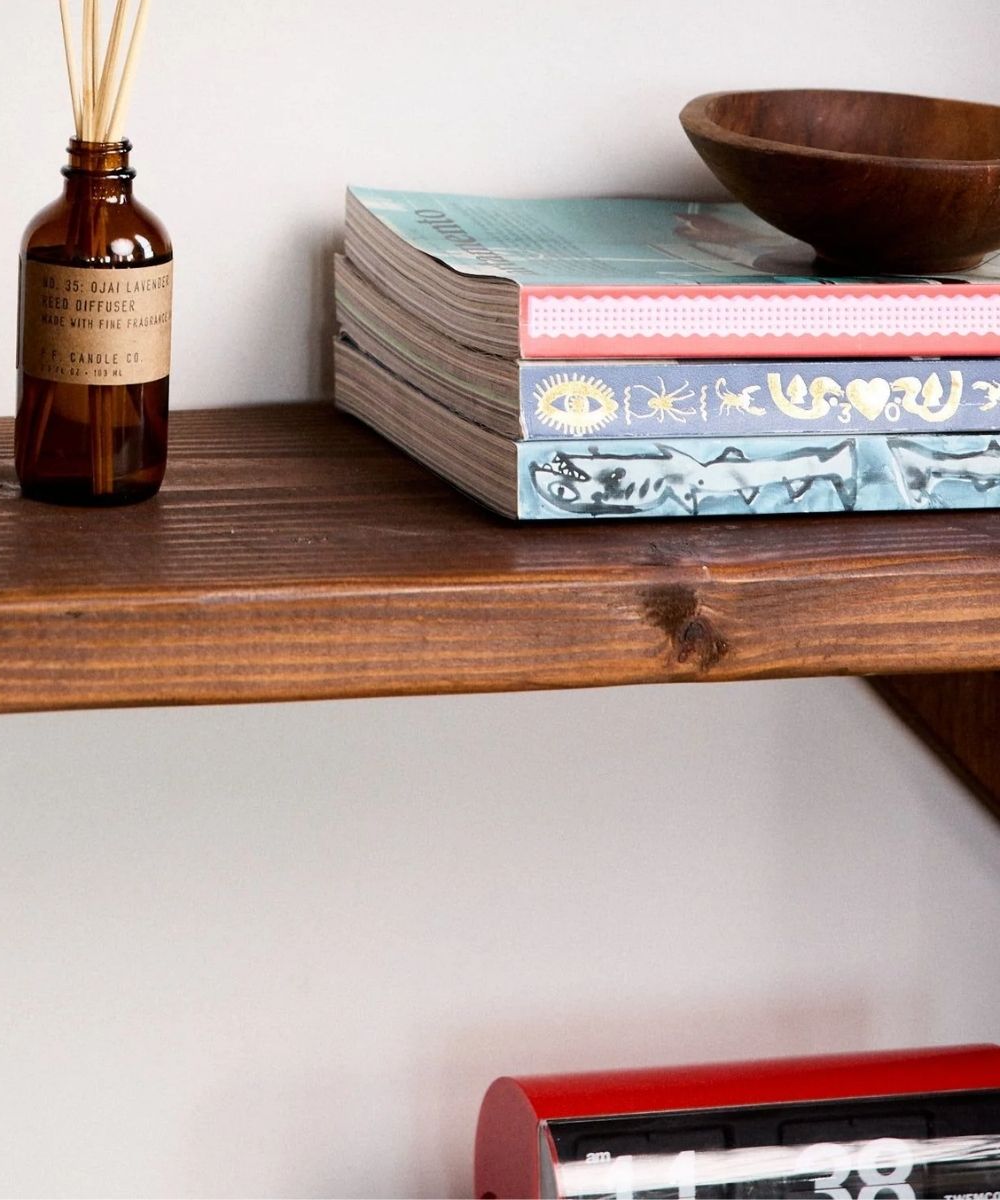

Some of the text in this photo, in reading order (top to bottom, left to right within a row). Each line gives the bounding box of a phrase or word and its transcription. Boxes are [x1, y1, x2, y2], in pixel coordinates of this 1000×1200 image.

[65, 280, 83, 293] 35:
[91, 281, 119, 294] OJAI
[127, 274, 169, 293] LAVENDER
[41, 294, 135, 313] REED DIFFUSER
[41, 313, 65, 327] MADE
[71, 318, 94, 329] WITH
[99, 319, 121, 330] FINE
[70, 352, 119, 364] CANDLE
[126, 352, 143, 363] CO.
[586, 1151, 612, 1164] am
